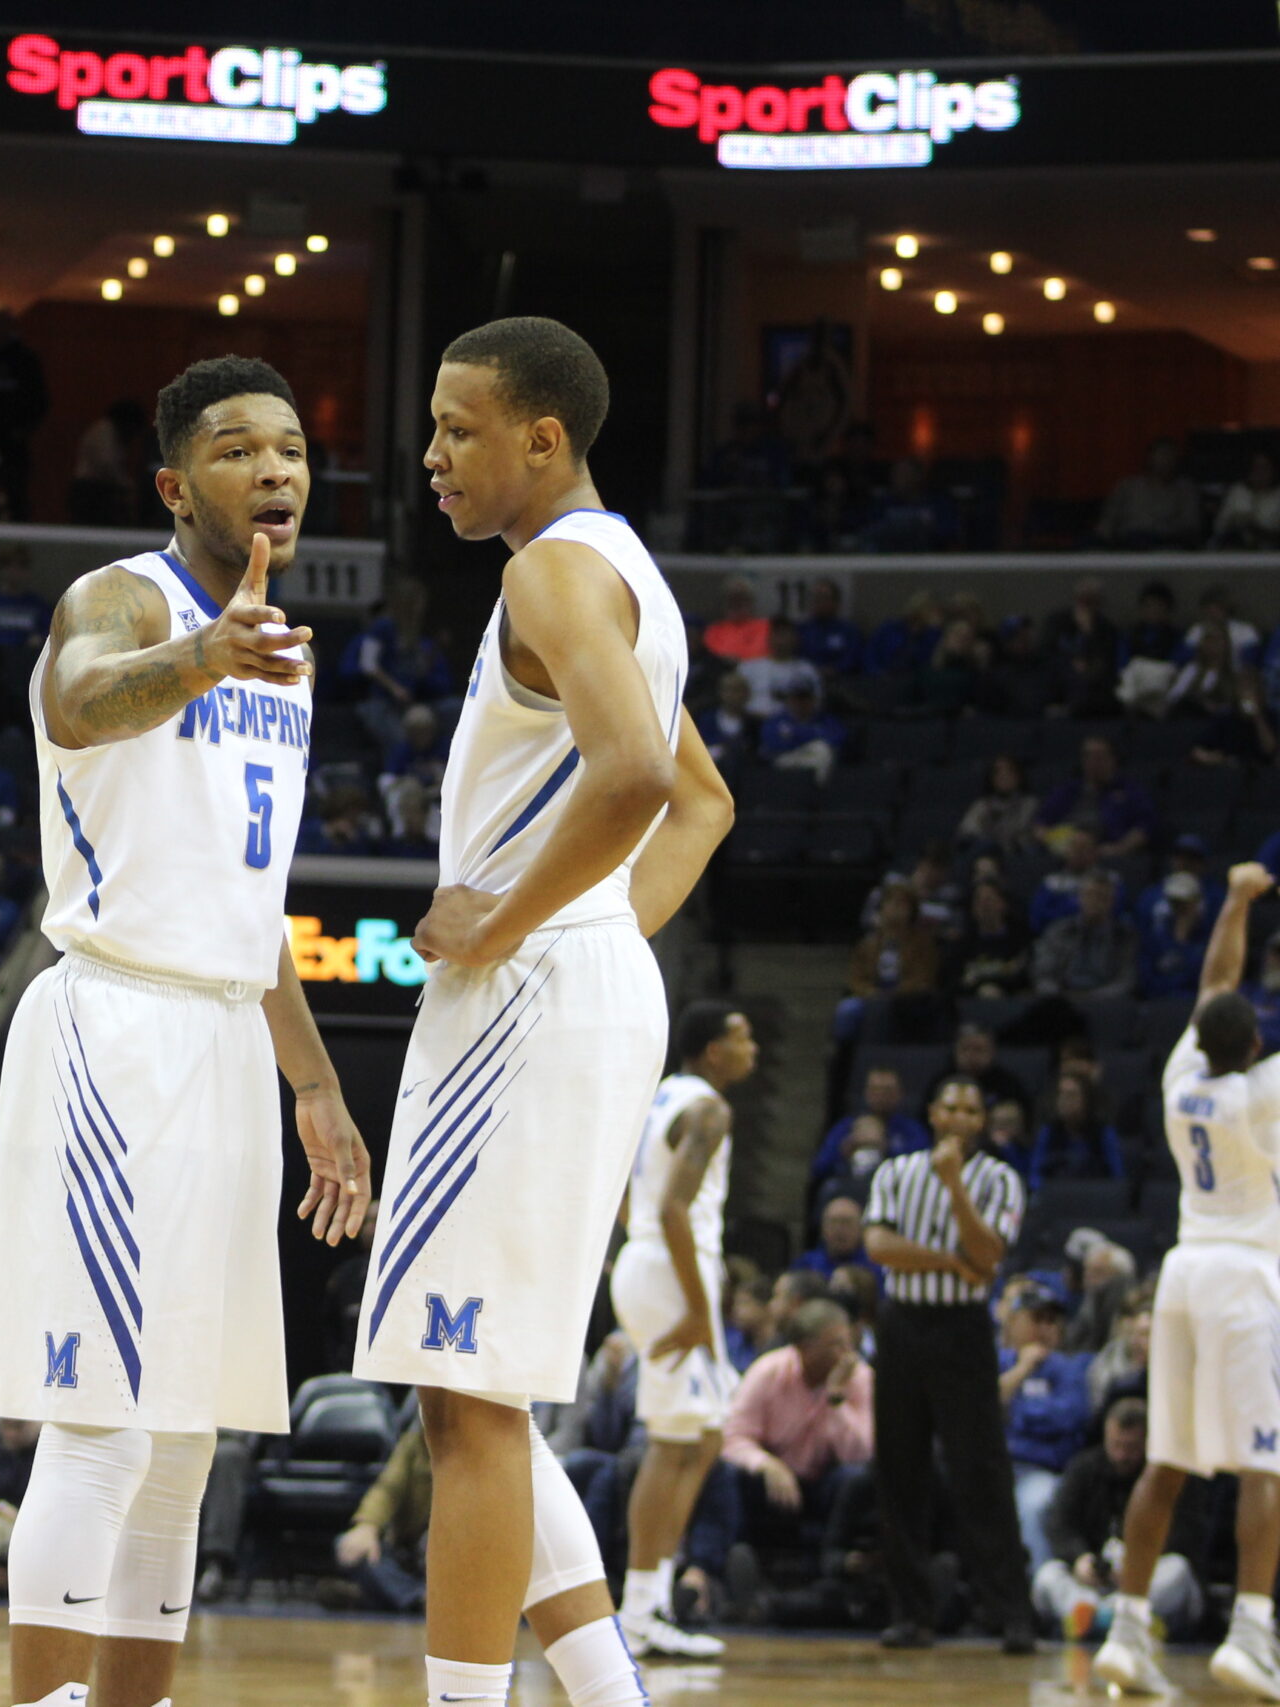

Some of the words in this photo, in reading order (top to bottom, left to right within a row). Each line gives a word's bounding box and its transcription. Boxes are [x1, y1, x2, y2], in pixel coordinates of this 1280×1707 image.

[305, 561, 359, 598] 111
[243, 761, 274, 871] 5
[1189, 1123, 1216, 1192] 3
[420, 1292, 483, 1355] M
[43, 1331, 81, 1389] M
